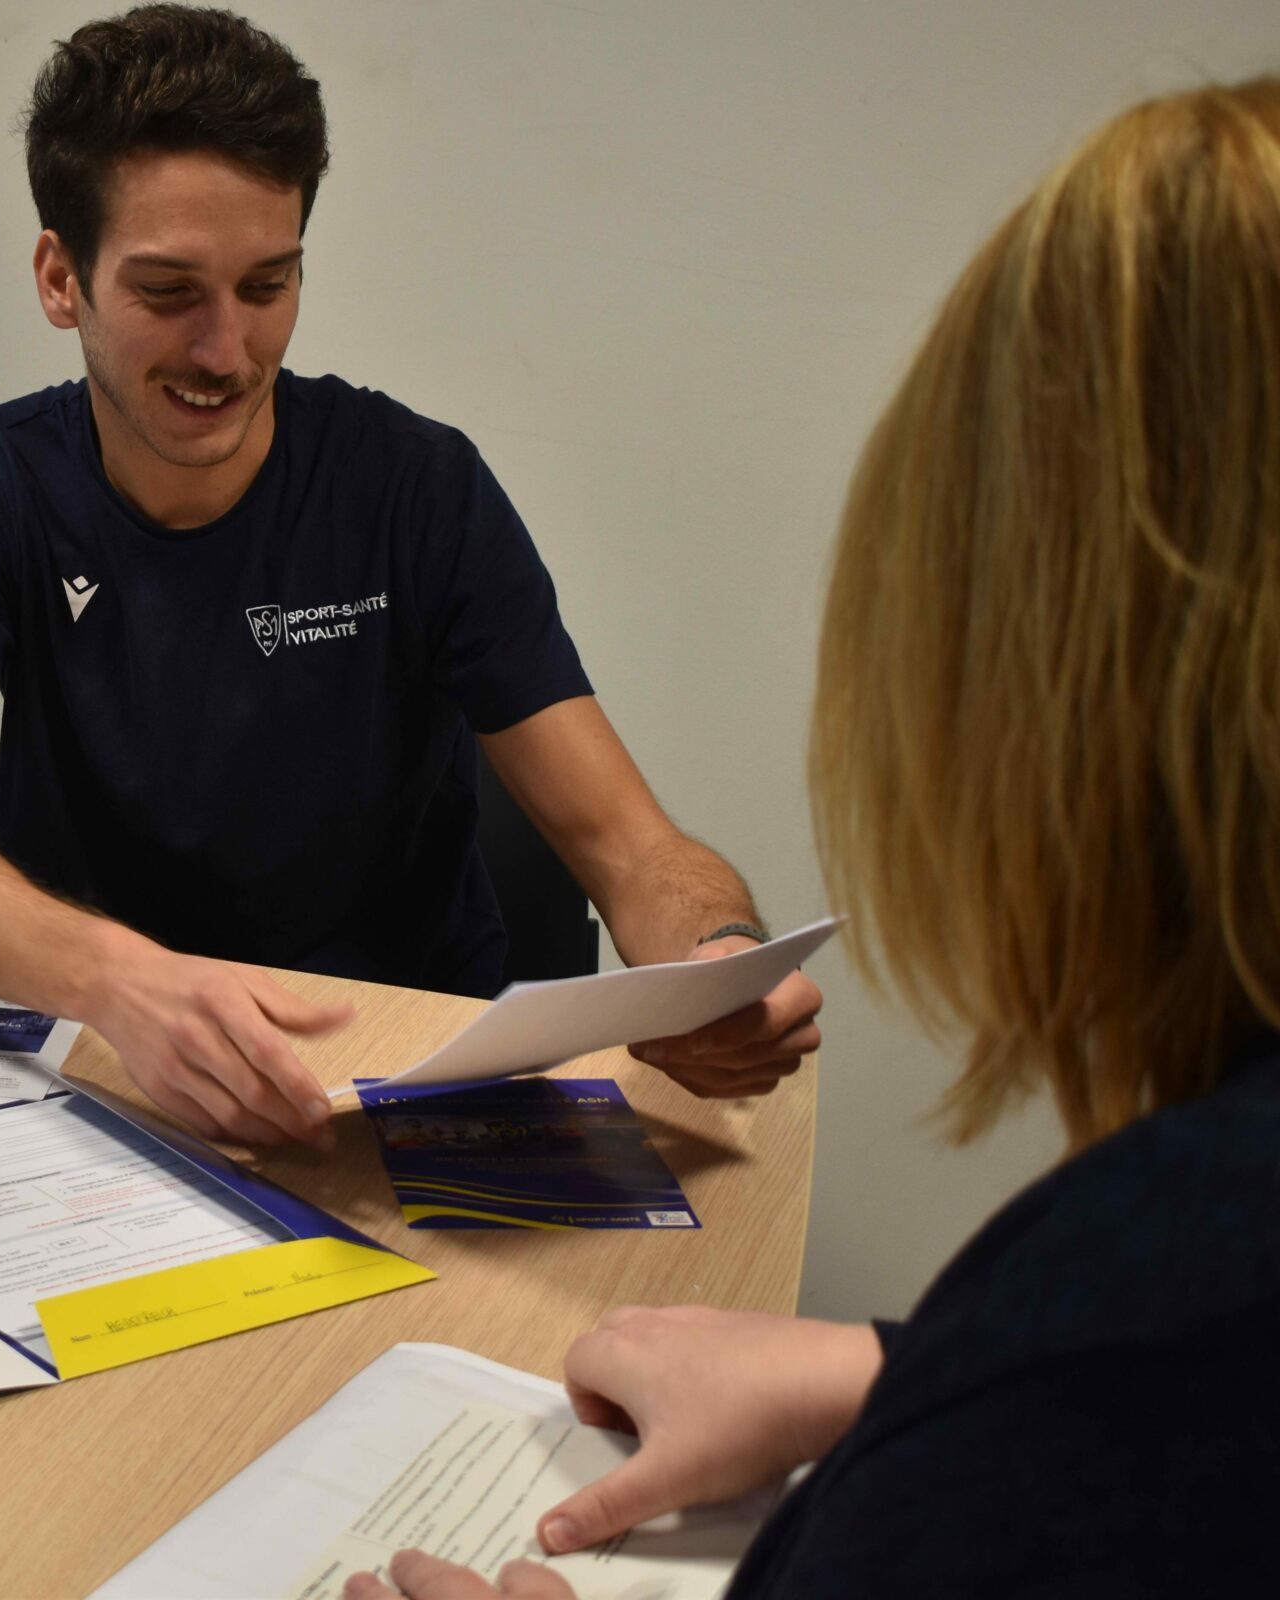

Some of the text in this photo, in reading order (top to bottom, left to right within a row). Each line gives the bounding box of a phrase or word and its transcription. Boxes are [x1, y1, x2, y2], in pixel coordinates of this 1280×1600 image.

[287, 592, 388, 625] SPORT-SANTÉ
[289, 619, 359, 646] VITALITÉ
[576, 1096, 610, 1104] ASM
[70, 1334, 92, 1344] Nom
